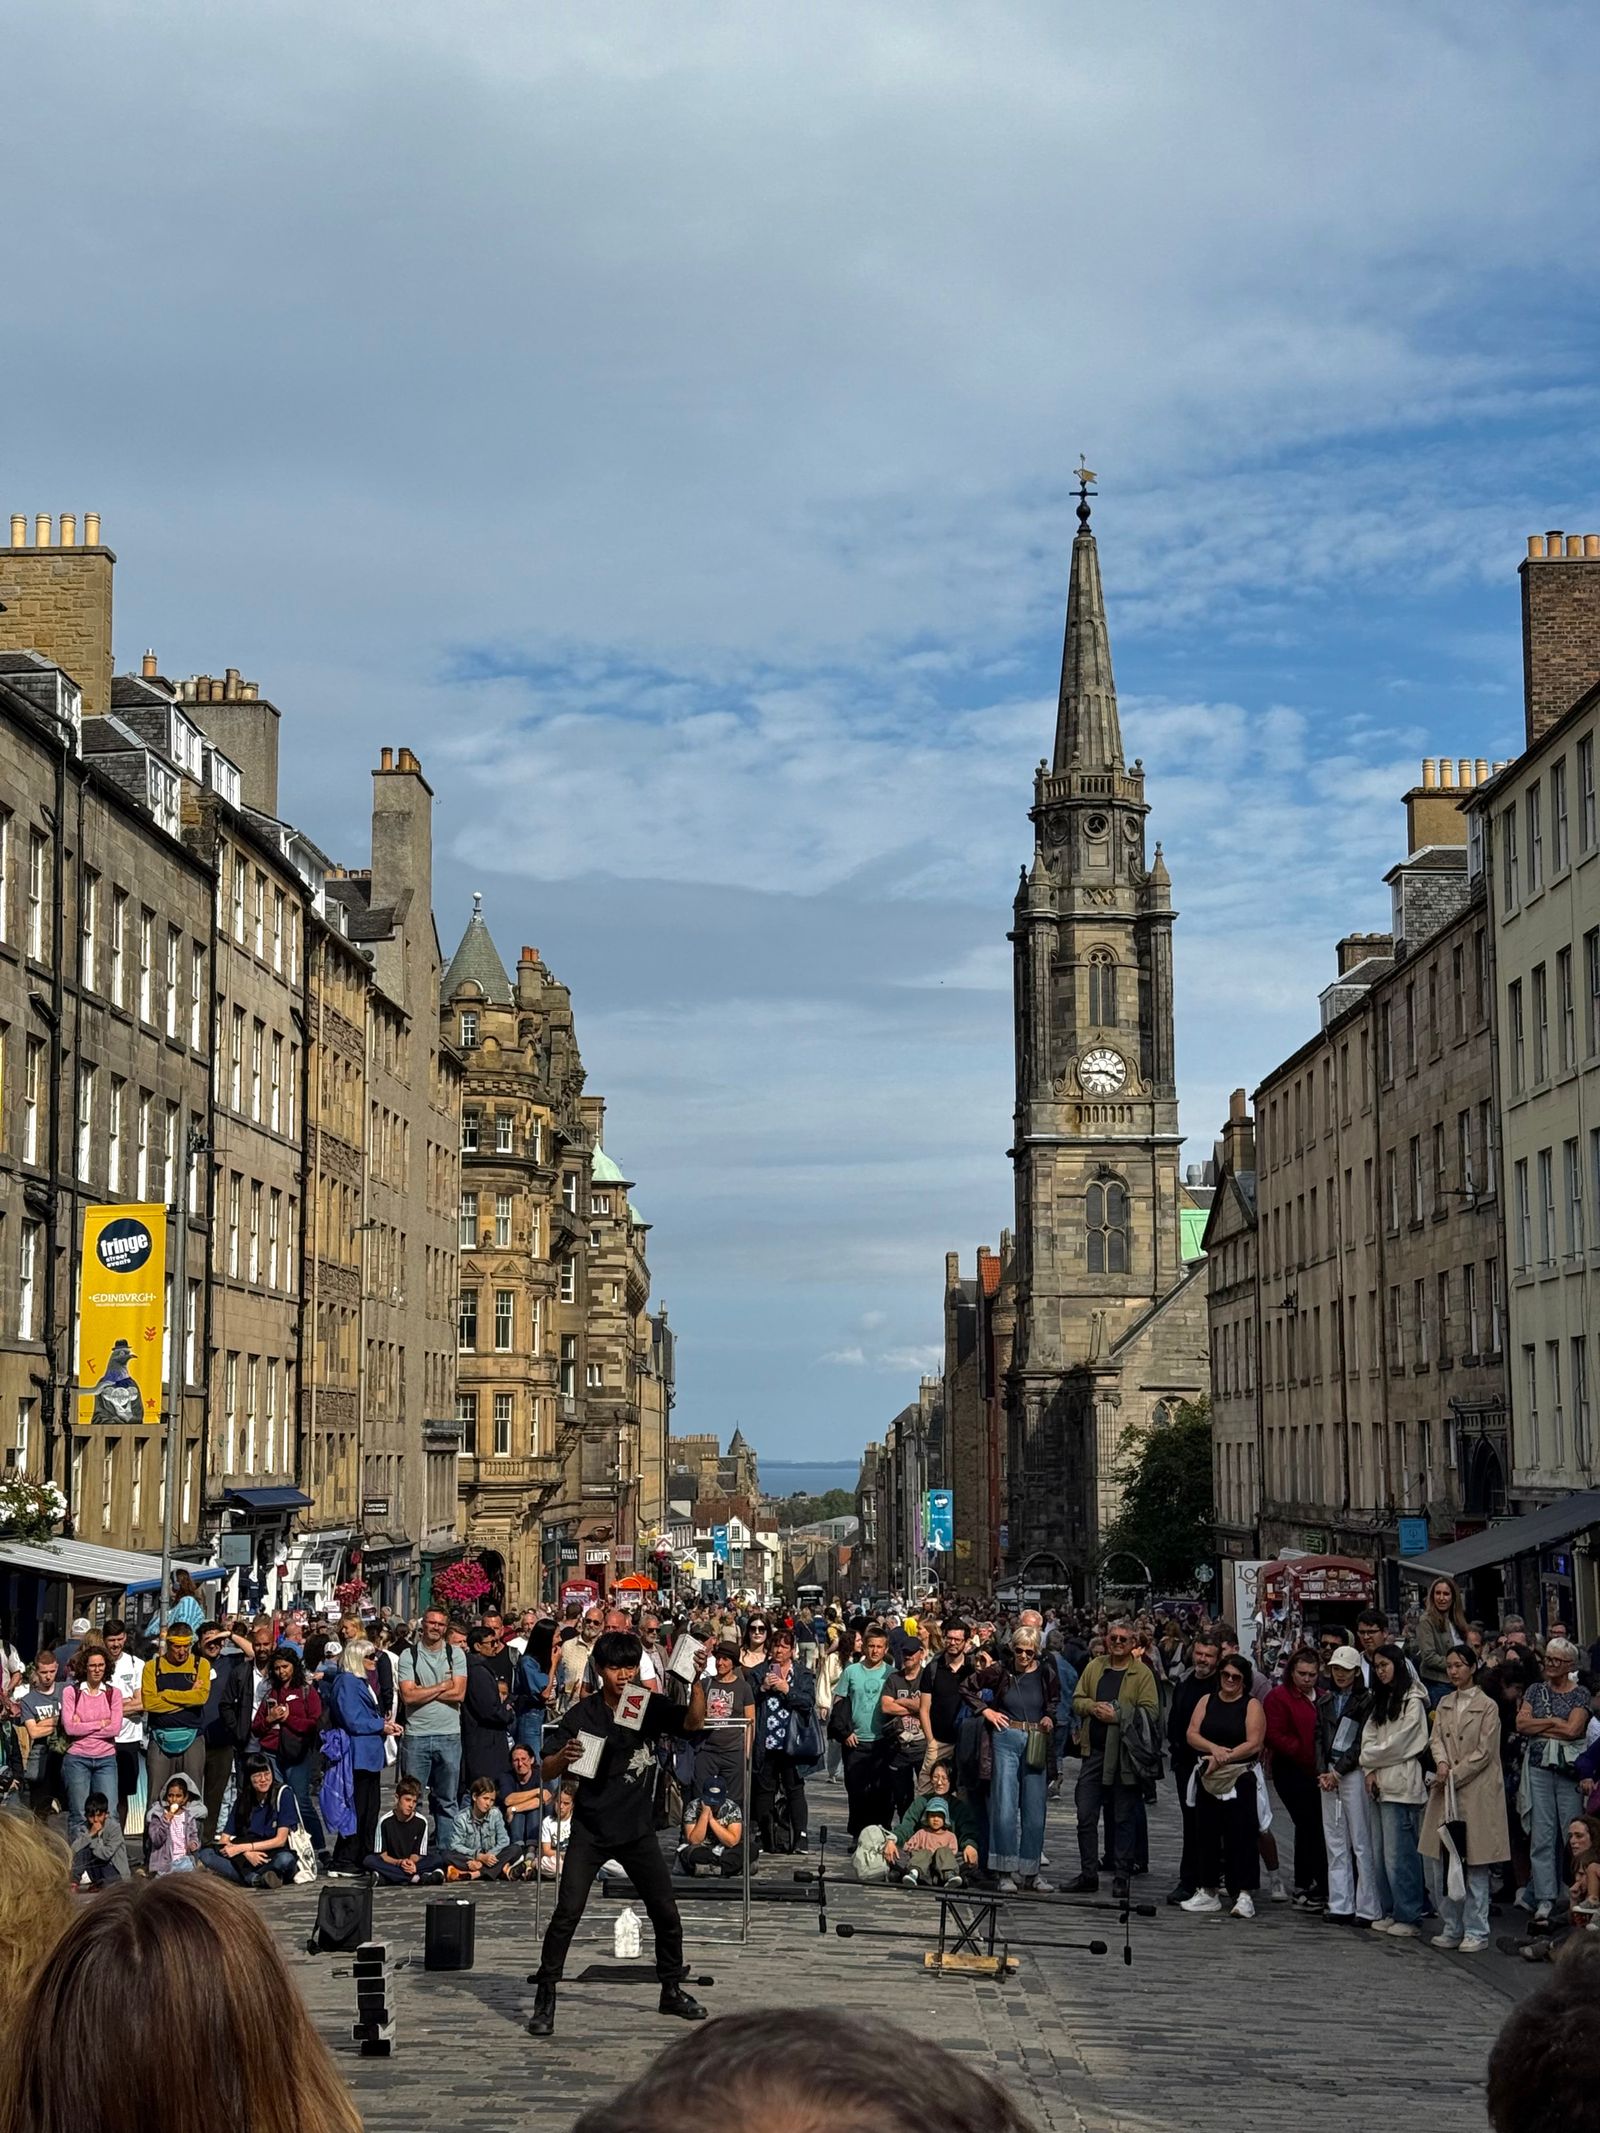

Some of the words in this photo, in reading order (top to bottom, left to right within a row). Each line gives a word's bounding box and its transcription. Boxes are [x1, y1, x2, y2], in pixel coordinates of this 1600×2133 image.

[100, 1234, 148, 1257] fringe
[105, 1253, 128, 1262] street
[106, 1258, 131, 1267] events
